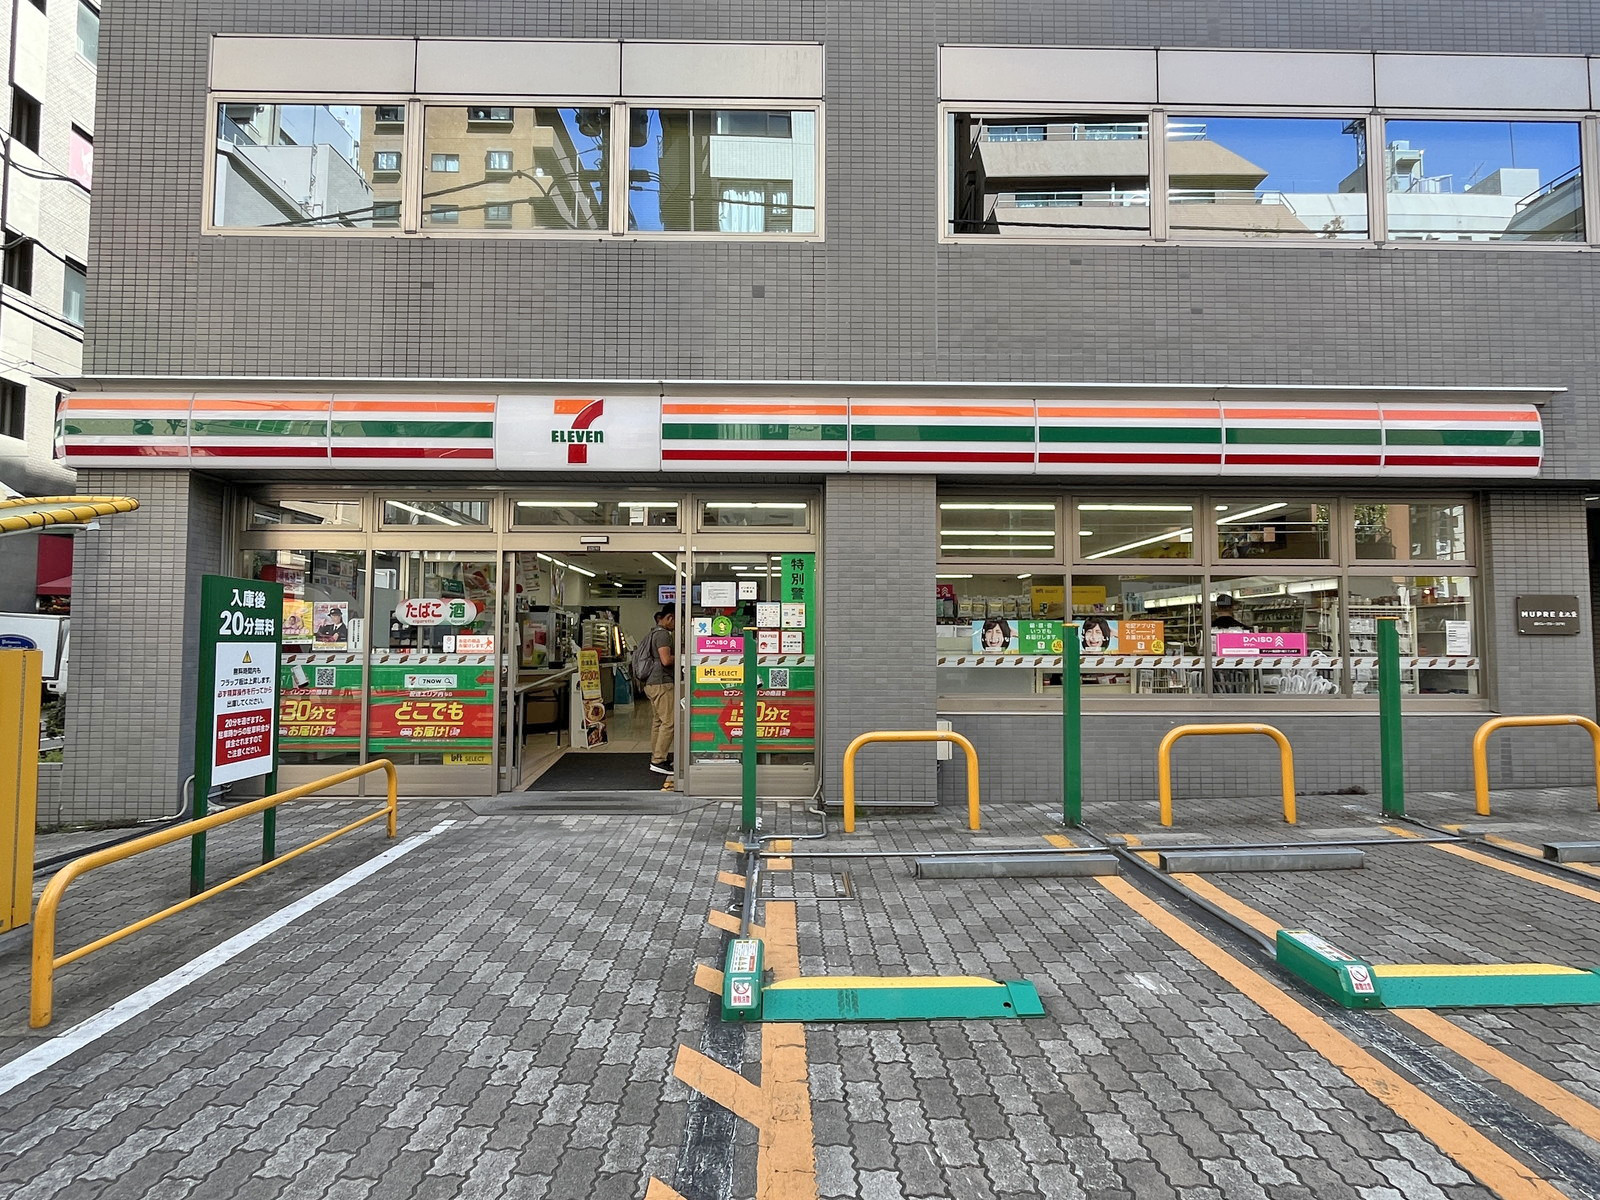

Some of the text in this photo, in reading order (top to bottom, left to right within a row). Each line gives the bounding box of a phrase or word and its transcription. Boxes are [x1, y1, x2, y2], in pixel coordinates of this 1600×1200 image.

[554, 399, 603, 463] 7
[230, 588, 267, 609] 入庫後
[405, 602, 466, 618] たばこ 酒
[1521, 610, 1556, 618] MUPRE
[219, 610, 275, 636] 20分無料
[226, 698, 264, 708] 出庫してください。
[282, 700, 336, 721] 30分で
[394, 702, 464, 720] どこでも
[288, 726, 325, 737] お届け!
[412, 726, 449, 737] お届け!
[227, 745, 261, 758] ご注意ください。
